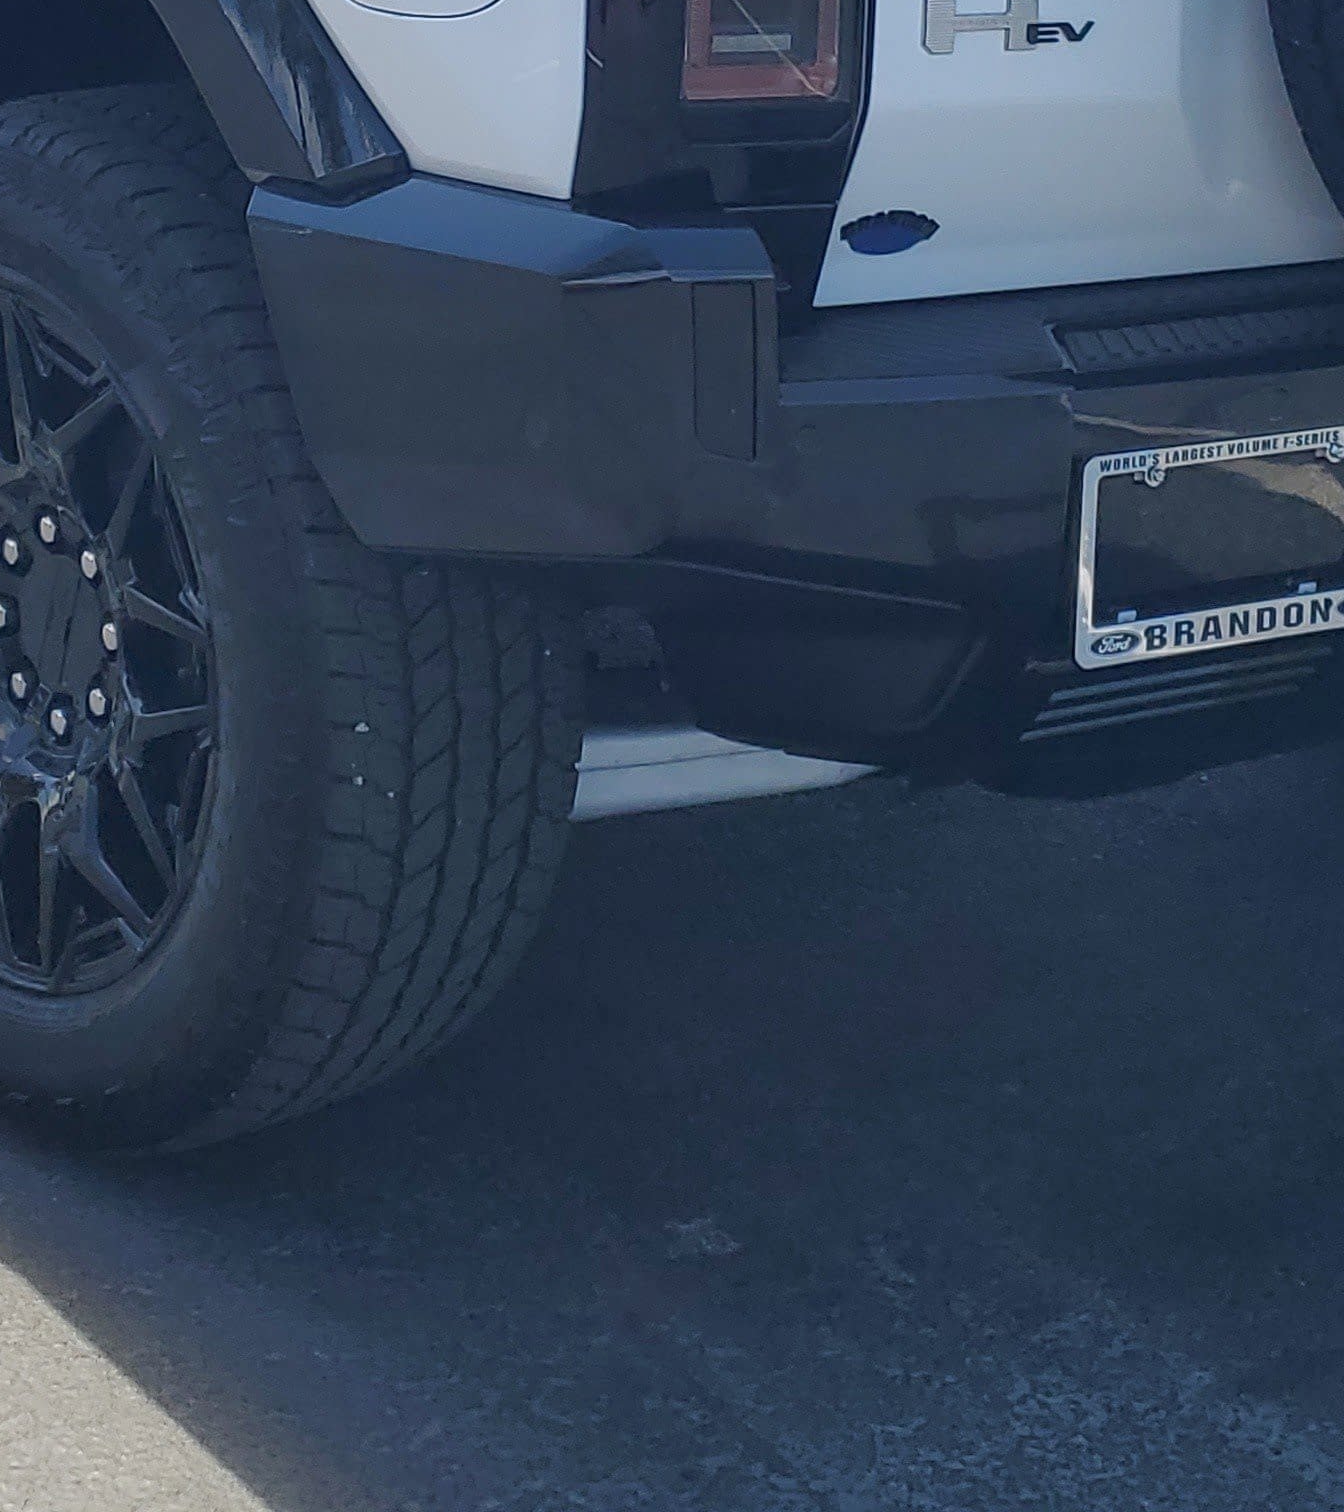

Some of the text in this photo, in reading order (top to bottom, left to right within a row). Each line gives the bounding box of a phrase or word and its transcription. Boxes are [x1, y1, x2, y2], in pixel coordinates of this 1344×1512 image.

[1099, 452, 1160, 473] WORLD'S
[1164, 445, 1224, 465] LARGEST
[1227, 438, 1279, 456] VOLUME
[1283, 430, 1340, 449] F-SERIES
[1097, 634, 1132, 655] Ford
[1144, 597, 1333, 651] BRANDON
